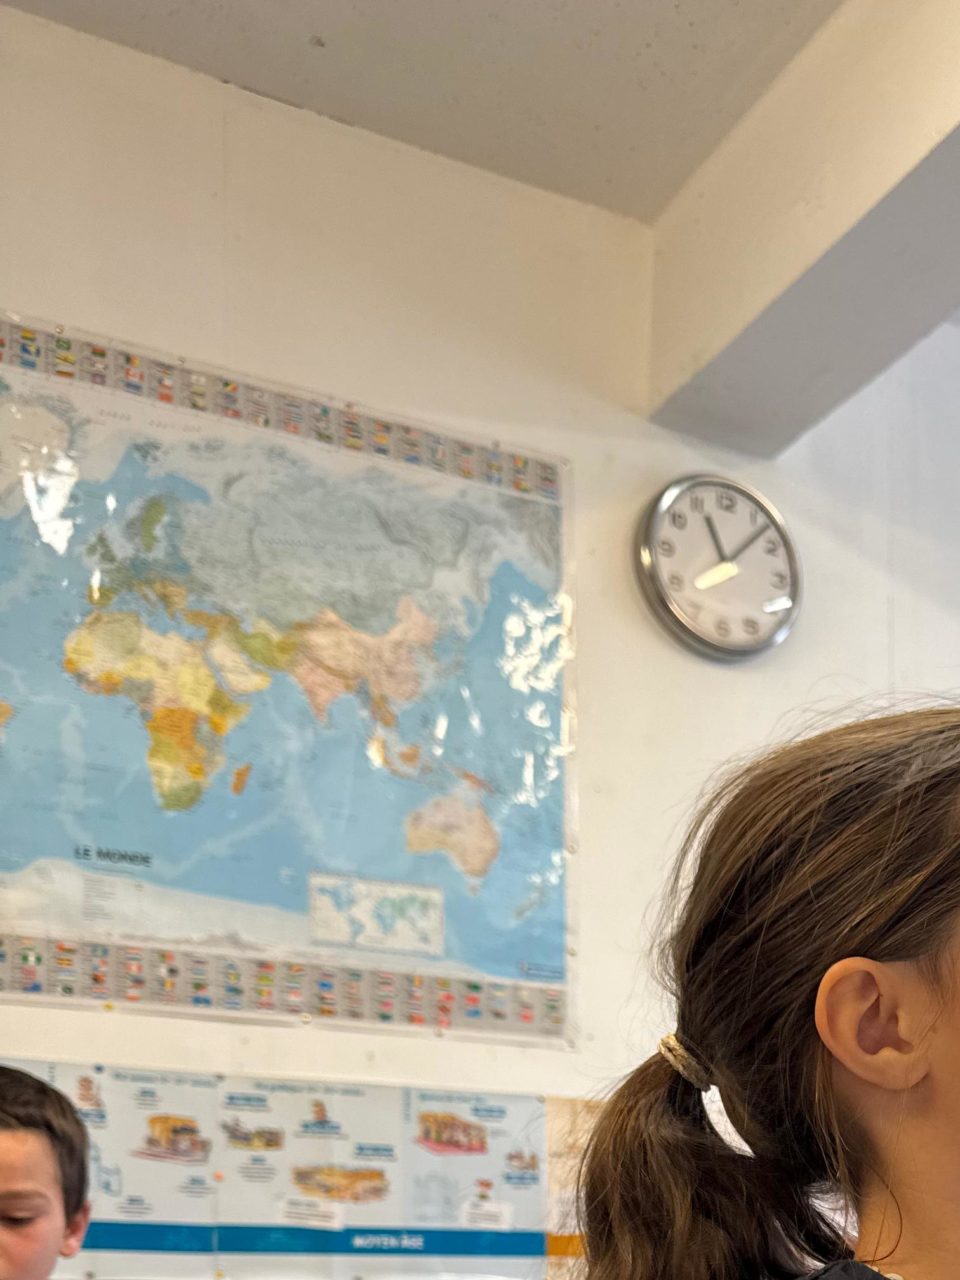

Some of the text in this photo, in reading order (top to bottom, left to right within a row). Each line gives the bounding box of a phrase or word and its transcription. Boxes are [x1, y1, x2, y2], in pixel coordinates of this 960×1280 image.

[718, 488, 738, 513] 12
[74, 844, 152, 868] LE MONDE
[352, 1234, 399, 1249] MOYEN
